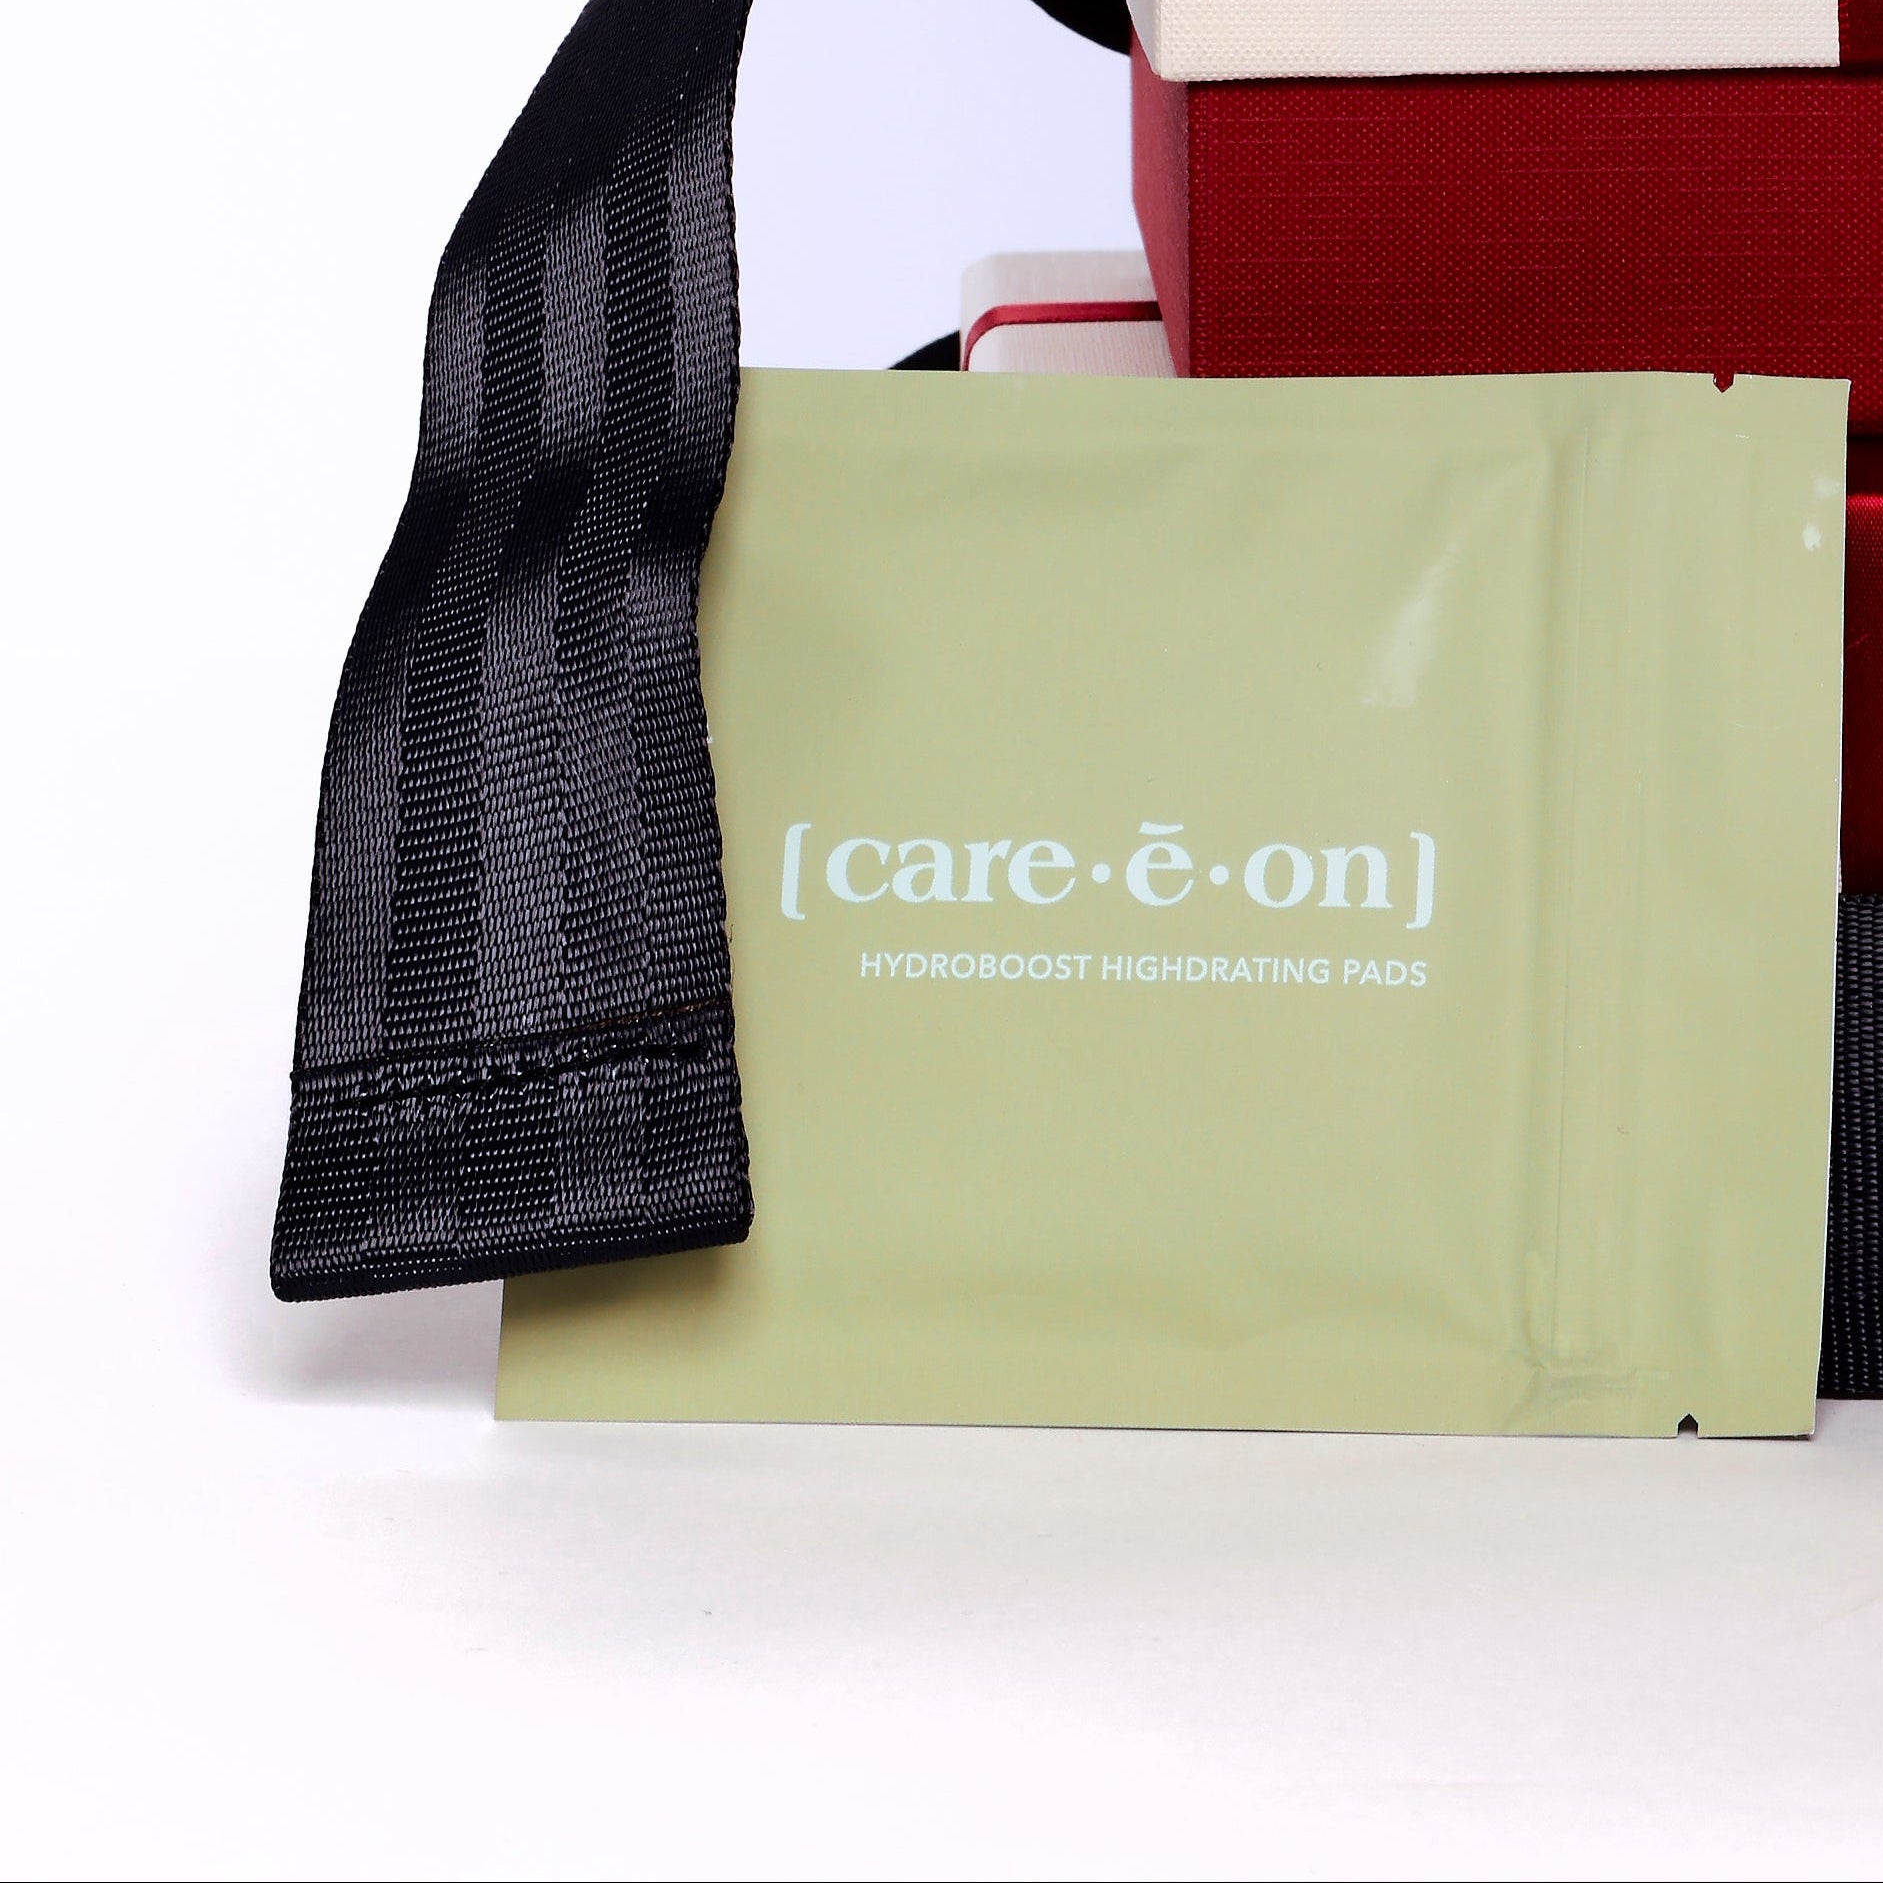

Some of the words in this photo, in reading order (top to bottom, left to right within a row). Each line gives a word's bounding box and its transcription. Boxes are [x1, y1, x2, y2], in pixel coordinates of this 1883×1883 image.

[859, 950, 1094, 982] HYDROBOOST
[1101, 953, 1331, 985] HIGHDRATING
[1342, 956, 1428, 989] PADS
